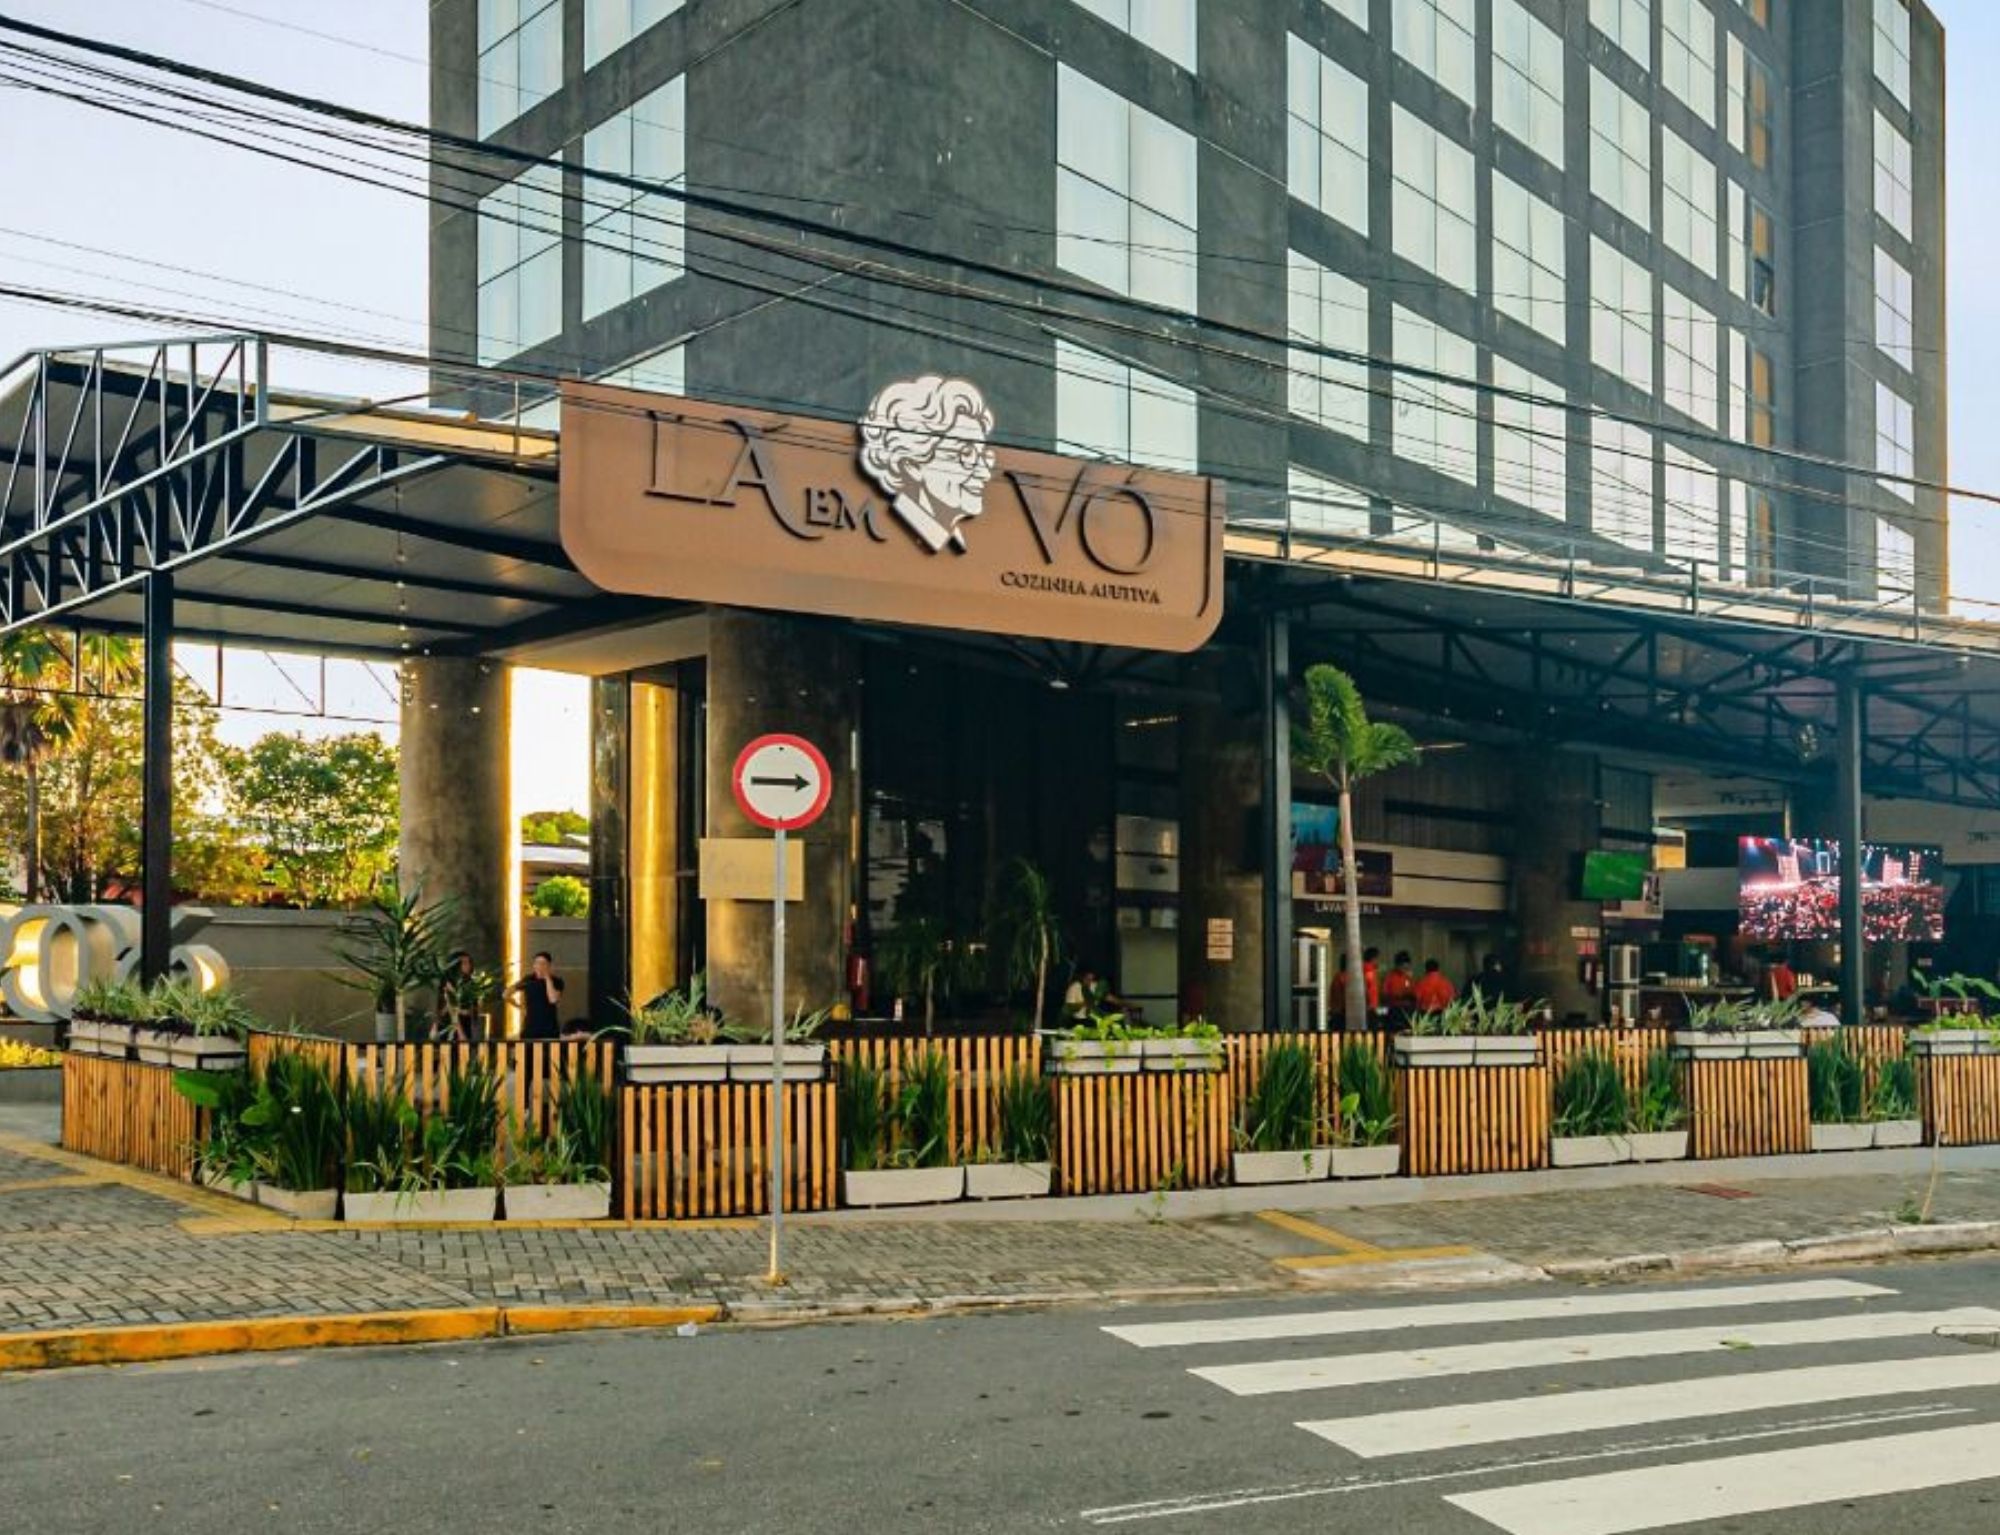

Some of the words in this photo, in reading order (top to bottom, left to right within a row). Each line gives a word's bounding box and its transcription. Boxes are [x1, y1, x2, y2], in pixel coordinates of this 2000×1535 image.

[806, 487, 888, 543] EM
[1003, 464, 1156, 576] VÓ
[1000, 571, 1087, 596] COZINHA
